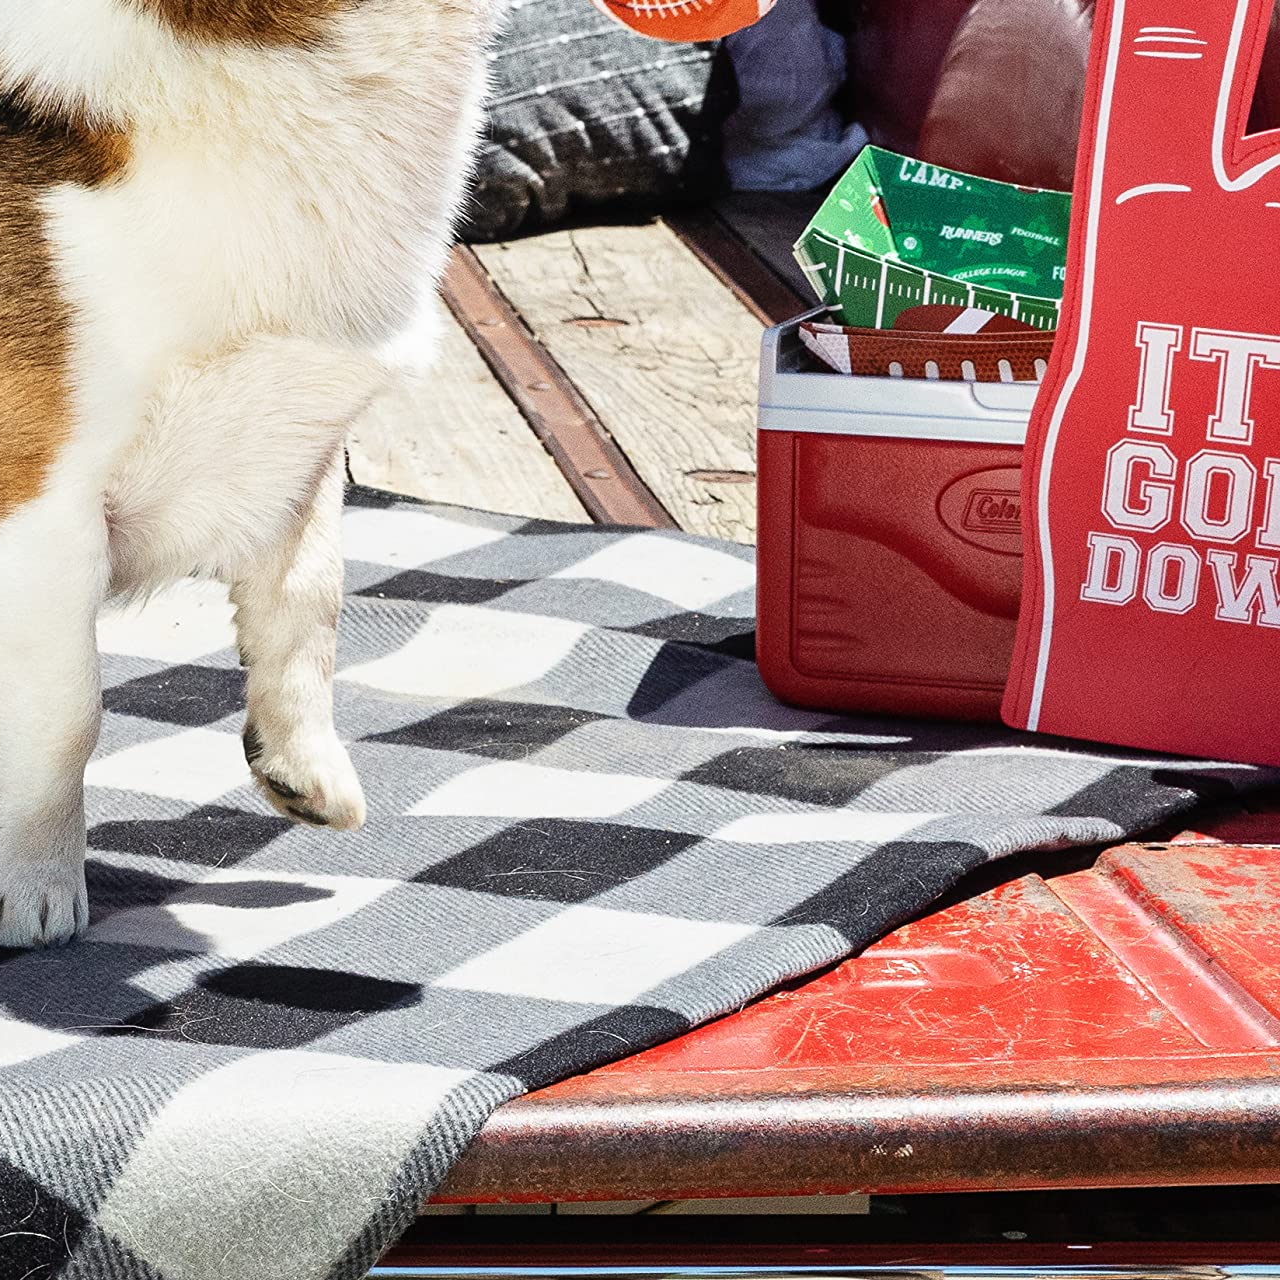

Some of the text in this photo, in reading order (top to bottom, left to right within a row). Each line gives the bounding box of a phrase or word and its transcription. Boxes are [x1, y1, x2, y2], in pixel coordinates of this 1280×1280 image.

[939, 225, 1003, 246] RUNNERS
[1010, 227, 1060, 246] FOOTBALL
[952, 268, 1028, 280] COLLEGE LEAGUE
